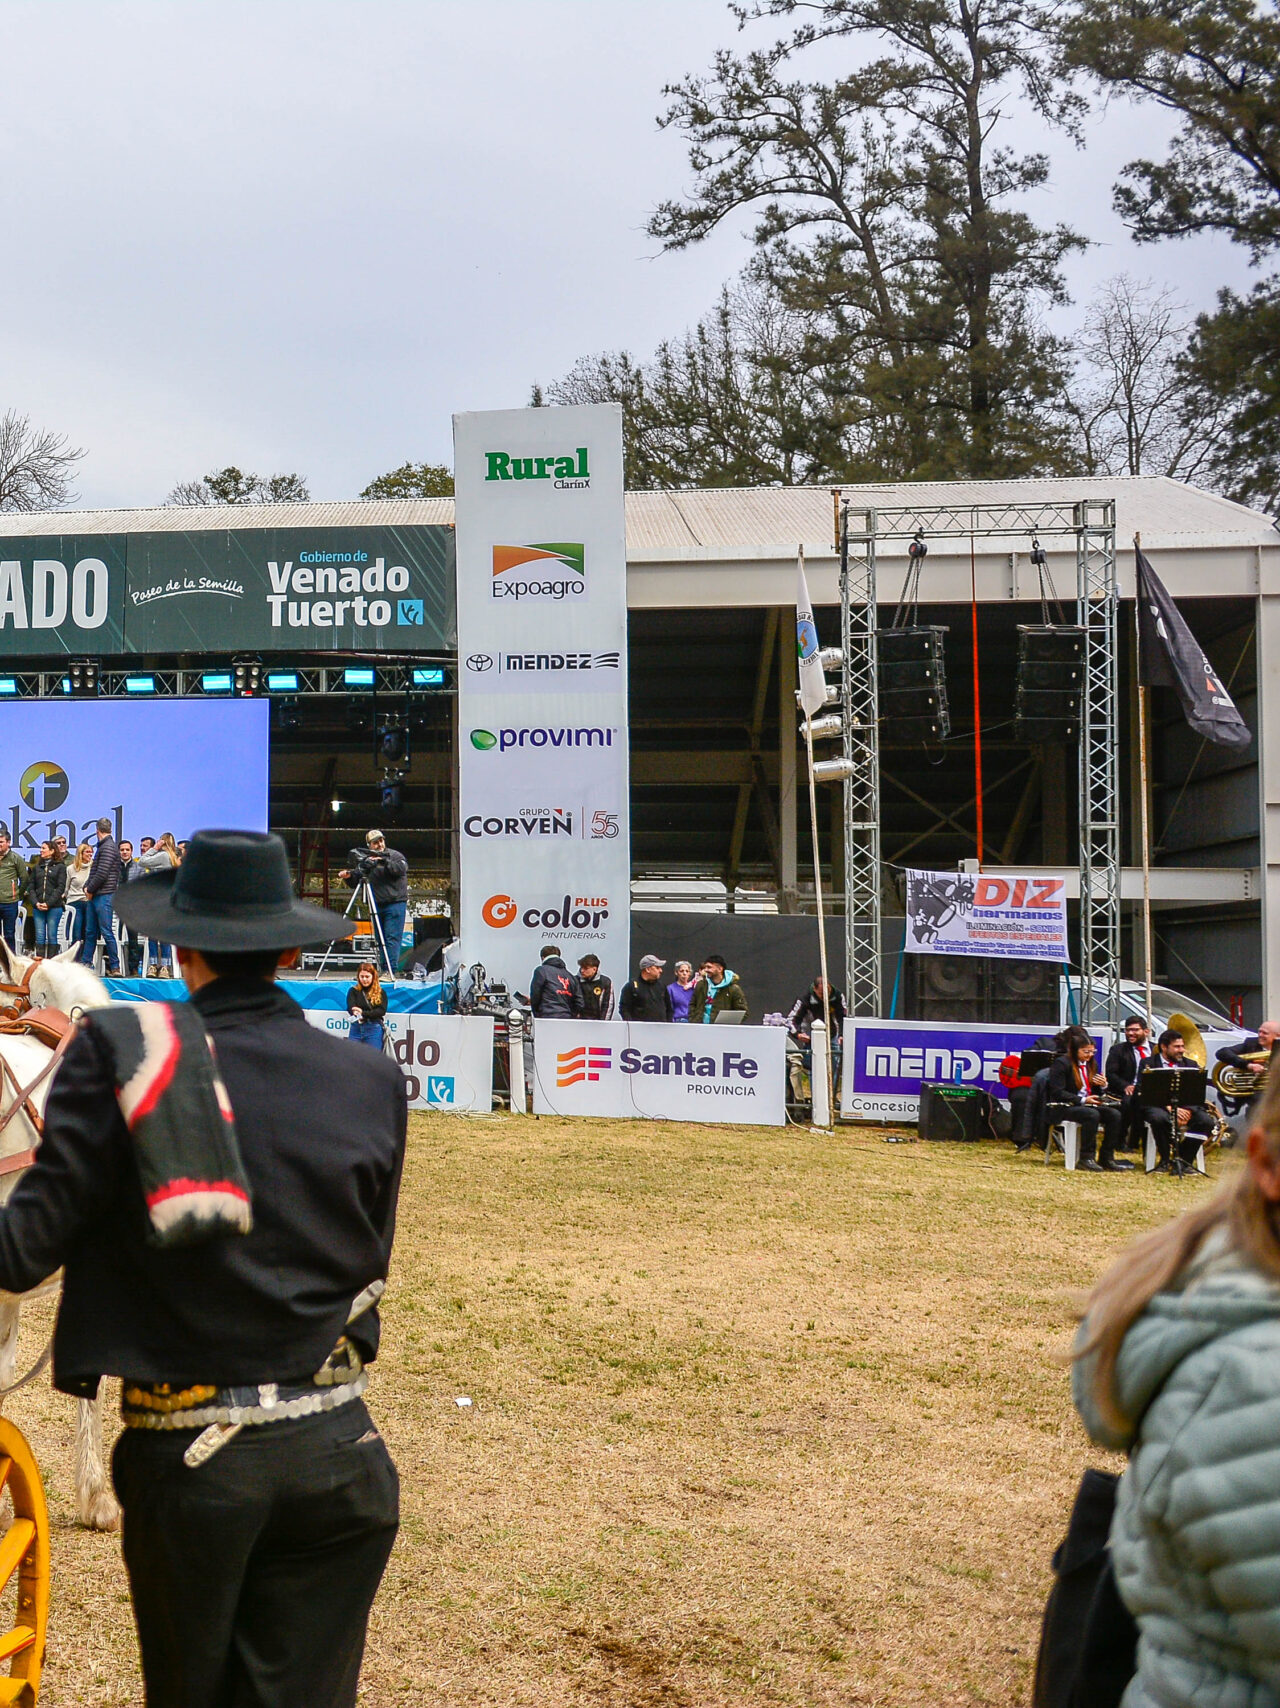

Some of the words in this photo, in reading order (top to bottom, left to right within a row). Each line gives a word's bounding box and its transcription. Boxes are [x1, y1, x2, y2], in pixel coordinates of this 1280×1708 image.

[484, 447, 590, 481] Rural
[299, 551, 352, 564] Gobierno
[353, 551, 368, 562] de
[267, 557, 410, 594] Venado
[131, 586, 163, 604] Paseo
[169, 579, 181, 590] de
[184, 577, 196, 589] la
[198, 577, 244, 594] Semilla
[492, 580, 585, 600] Expoagro
[266, 594, 392, 627] Tuerto
[506, 654, 592, 671] MENDEZ
[499, 728, 612, 752] provimi
[518, 808, 550, 817] GRUPO
[464, 814, 573, 838] CORVEN
[575, 897, 608, 907] PLUS
[973, 878, 1065, 909] DIZ
[522, 894, 609, 929] color
[972, 908, 1063, 921] hermanos
[541, 931, 607, 941] PINTURERIAS
[619, 1048, 716, 1078] Santa
[722, 1052, 759, 1079] Fe
[865, 1045, 1020, 1083] MENDE
[687, 1084, 756, 1097] PROVINCIA
